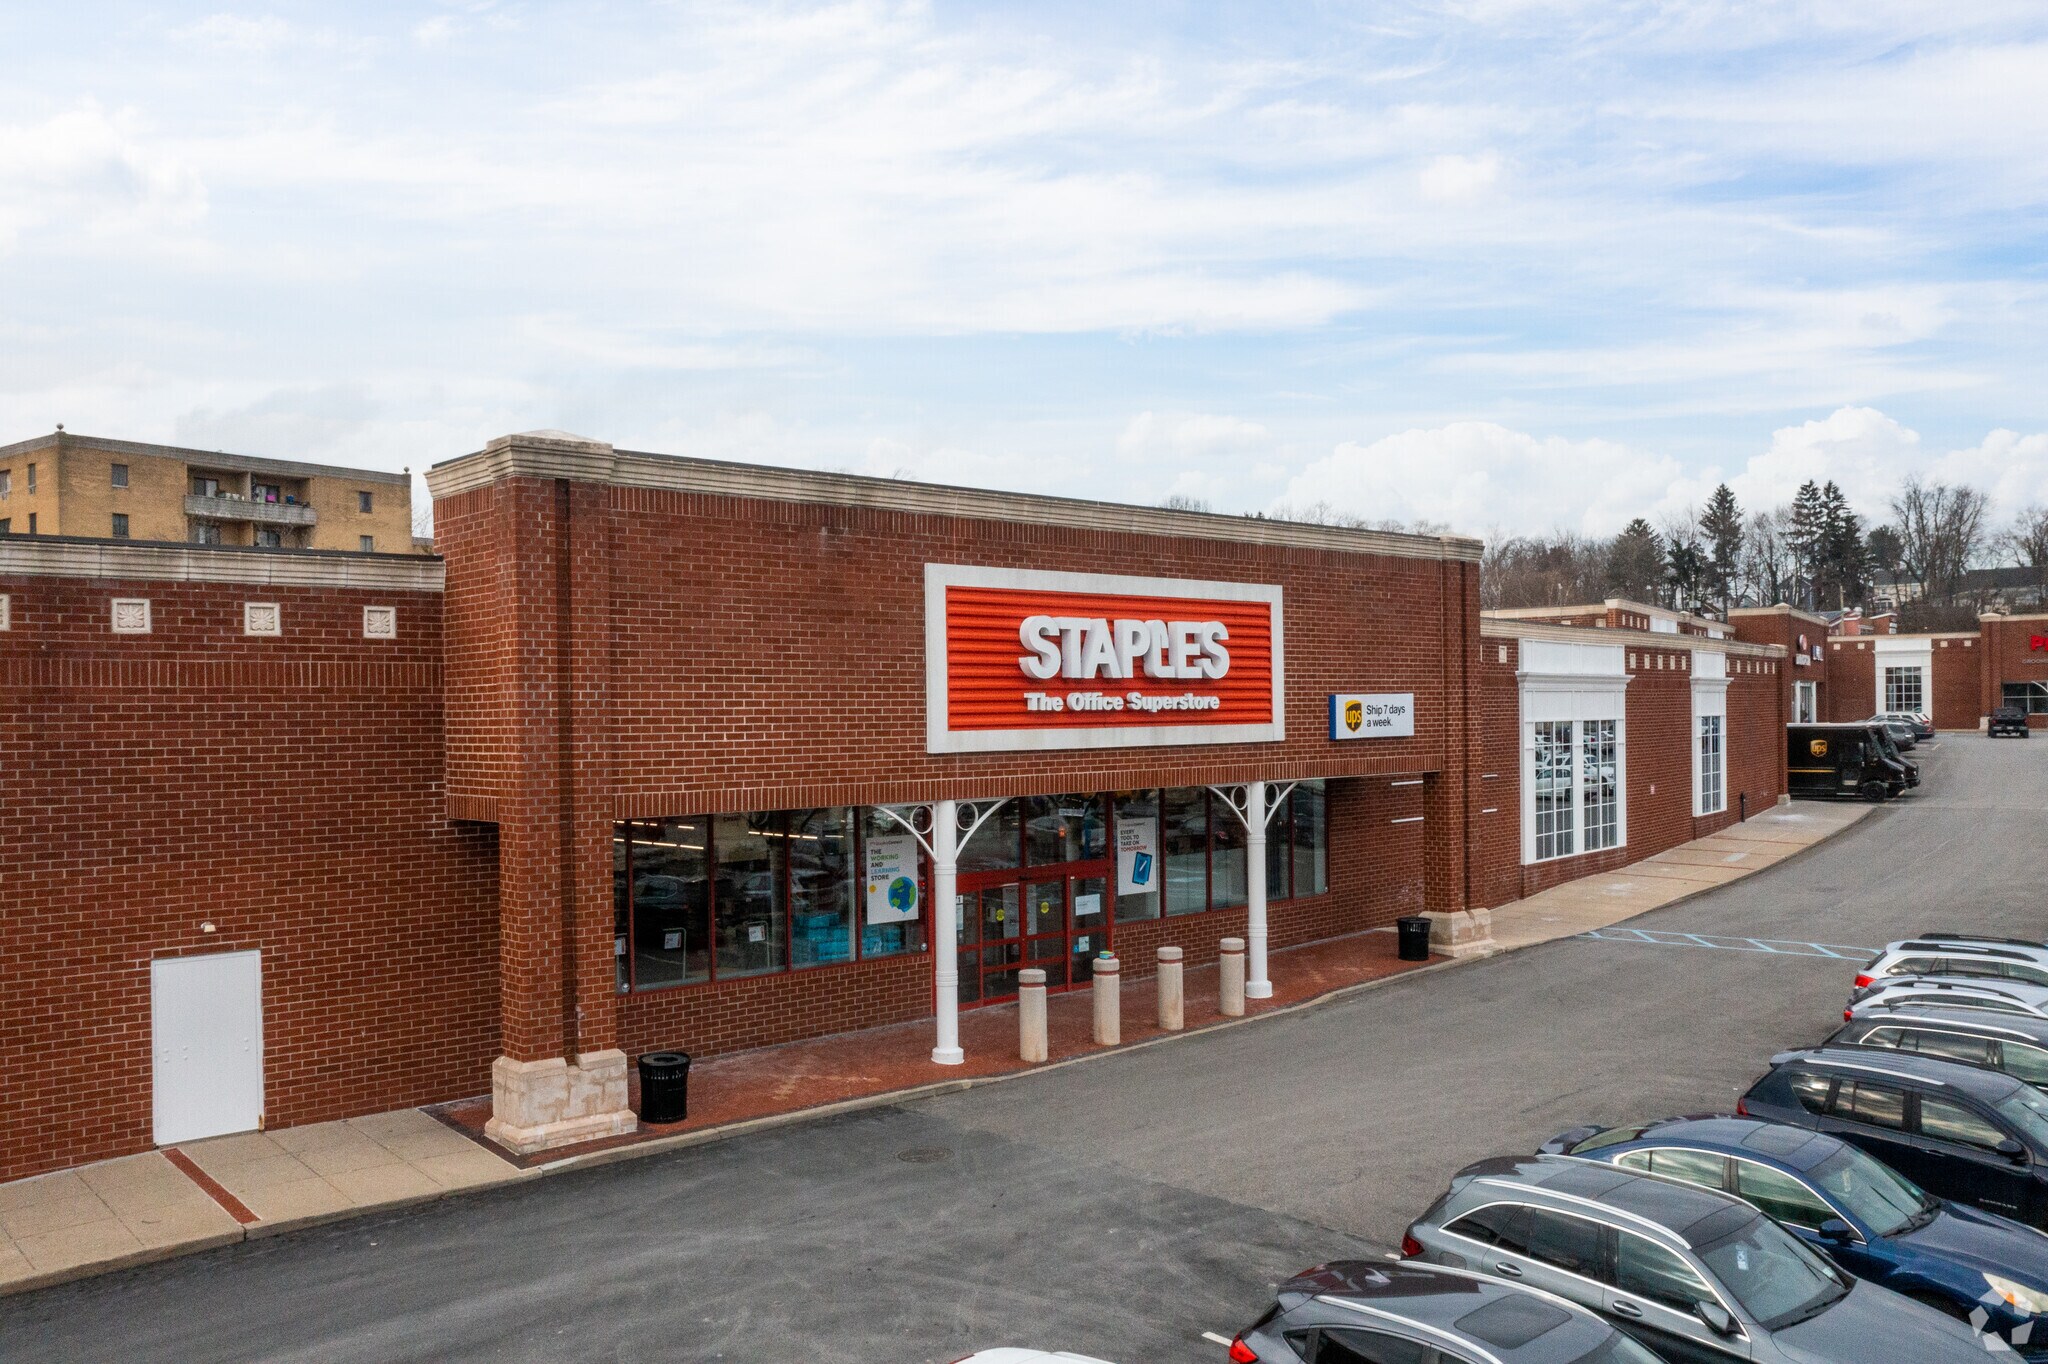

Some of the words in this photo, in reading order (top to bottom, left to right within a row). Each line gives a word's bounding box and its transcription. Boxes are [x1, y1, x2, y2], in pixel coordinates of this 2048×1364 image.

[1018, 615, 1230, 679] STAPLES
[1024, 692, 1064, 711] The
[1067, 692, 1124, 711] Office
[1126, 692, 1220, 712] Superstore
[1366, 705, 1382, 716] Ship
[1384, 705, 1388, 714] 7
[1389, 704, 1405, 715] days
[1346, 710, 1362, 728] ups
[1367, 719, 1372, 727] a
